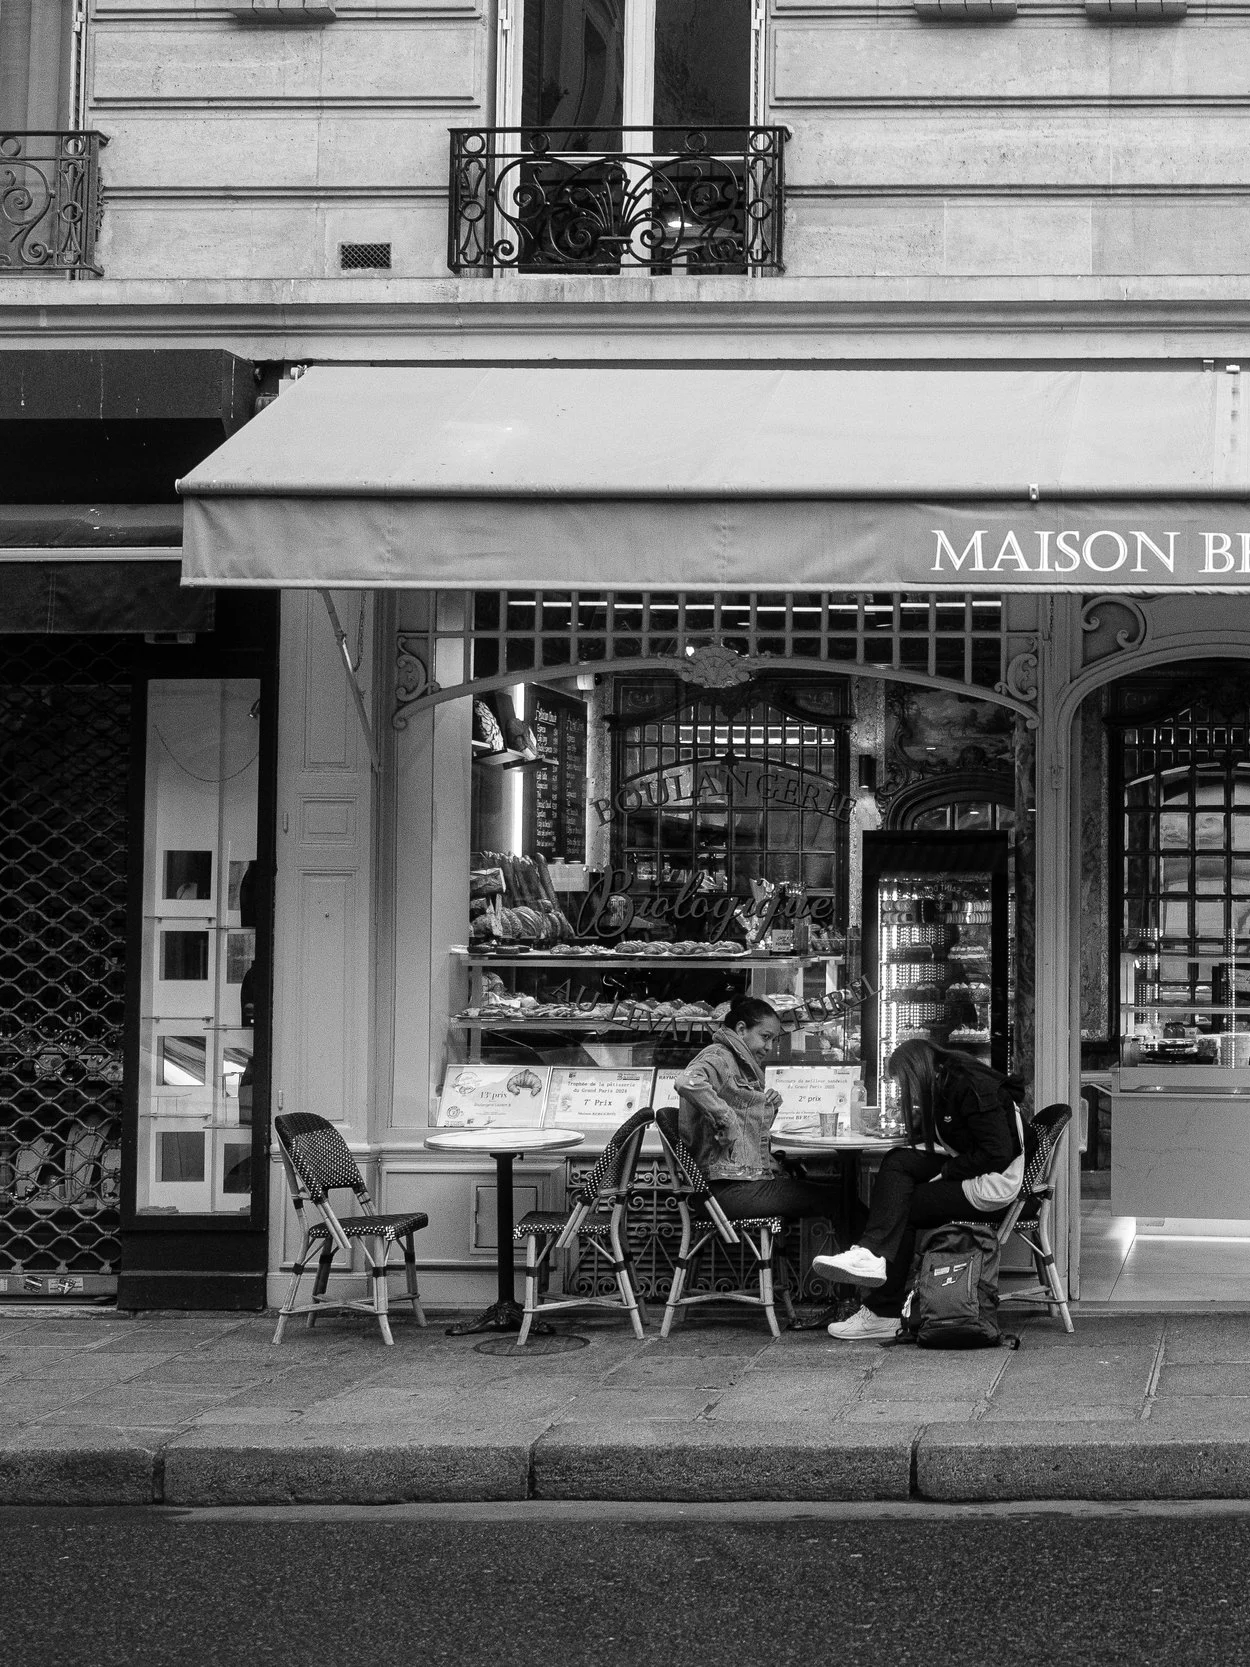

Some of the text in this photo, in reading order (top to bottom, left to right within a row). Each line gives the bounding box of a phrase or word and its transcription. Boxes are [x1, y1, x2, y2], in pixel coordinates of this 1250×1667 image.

[930, 529, 1182, 575] MAISON
[588, 767, 857, 829] BOULANGERIE
[575, 864, 834, 944] Biologique
[550, 978, 601, 1012] AU
